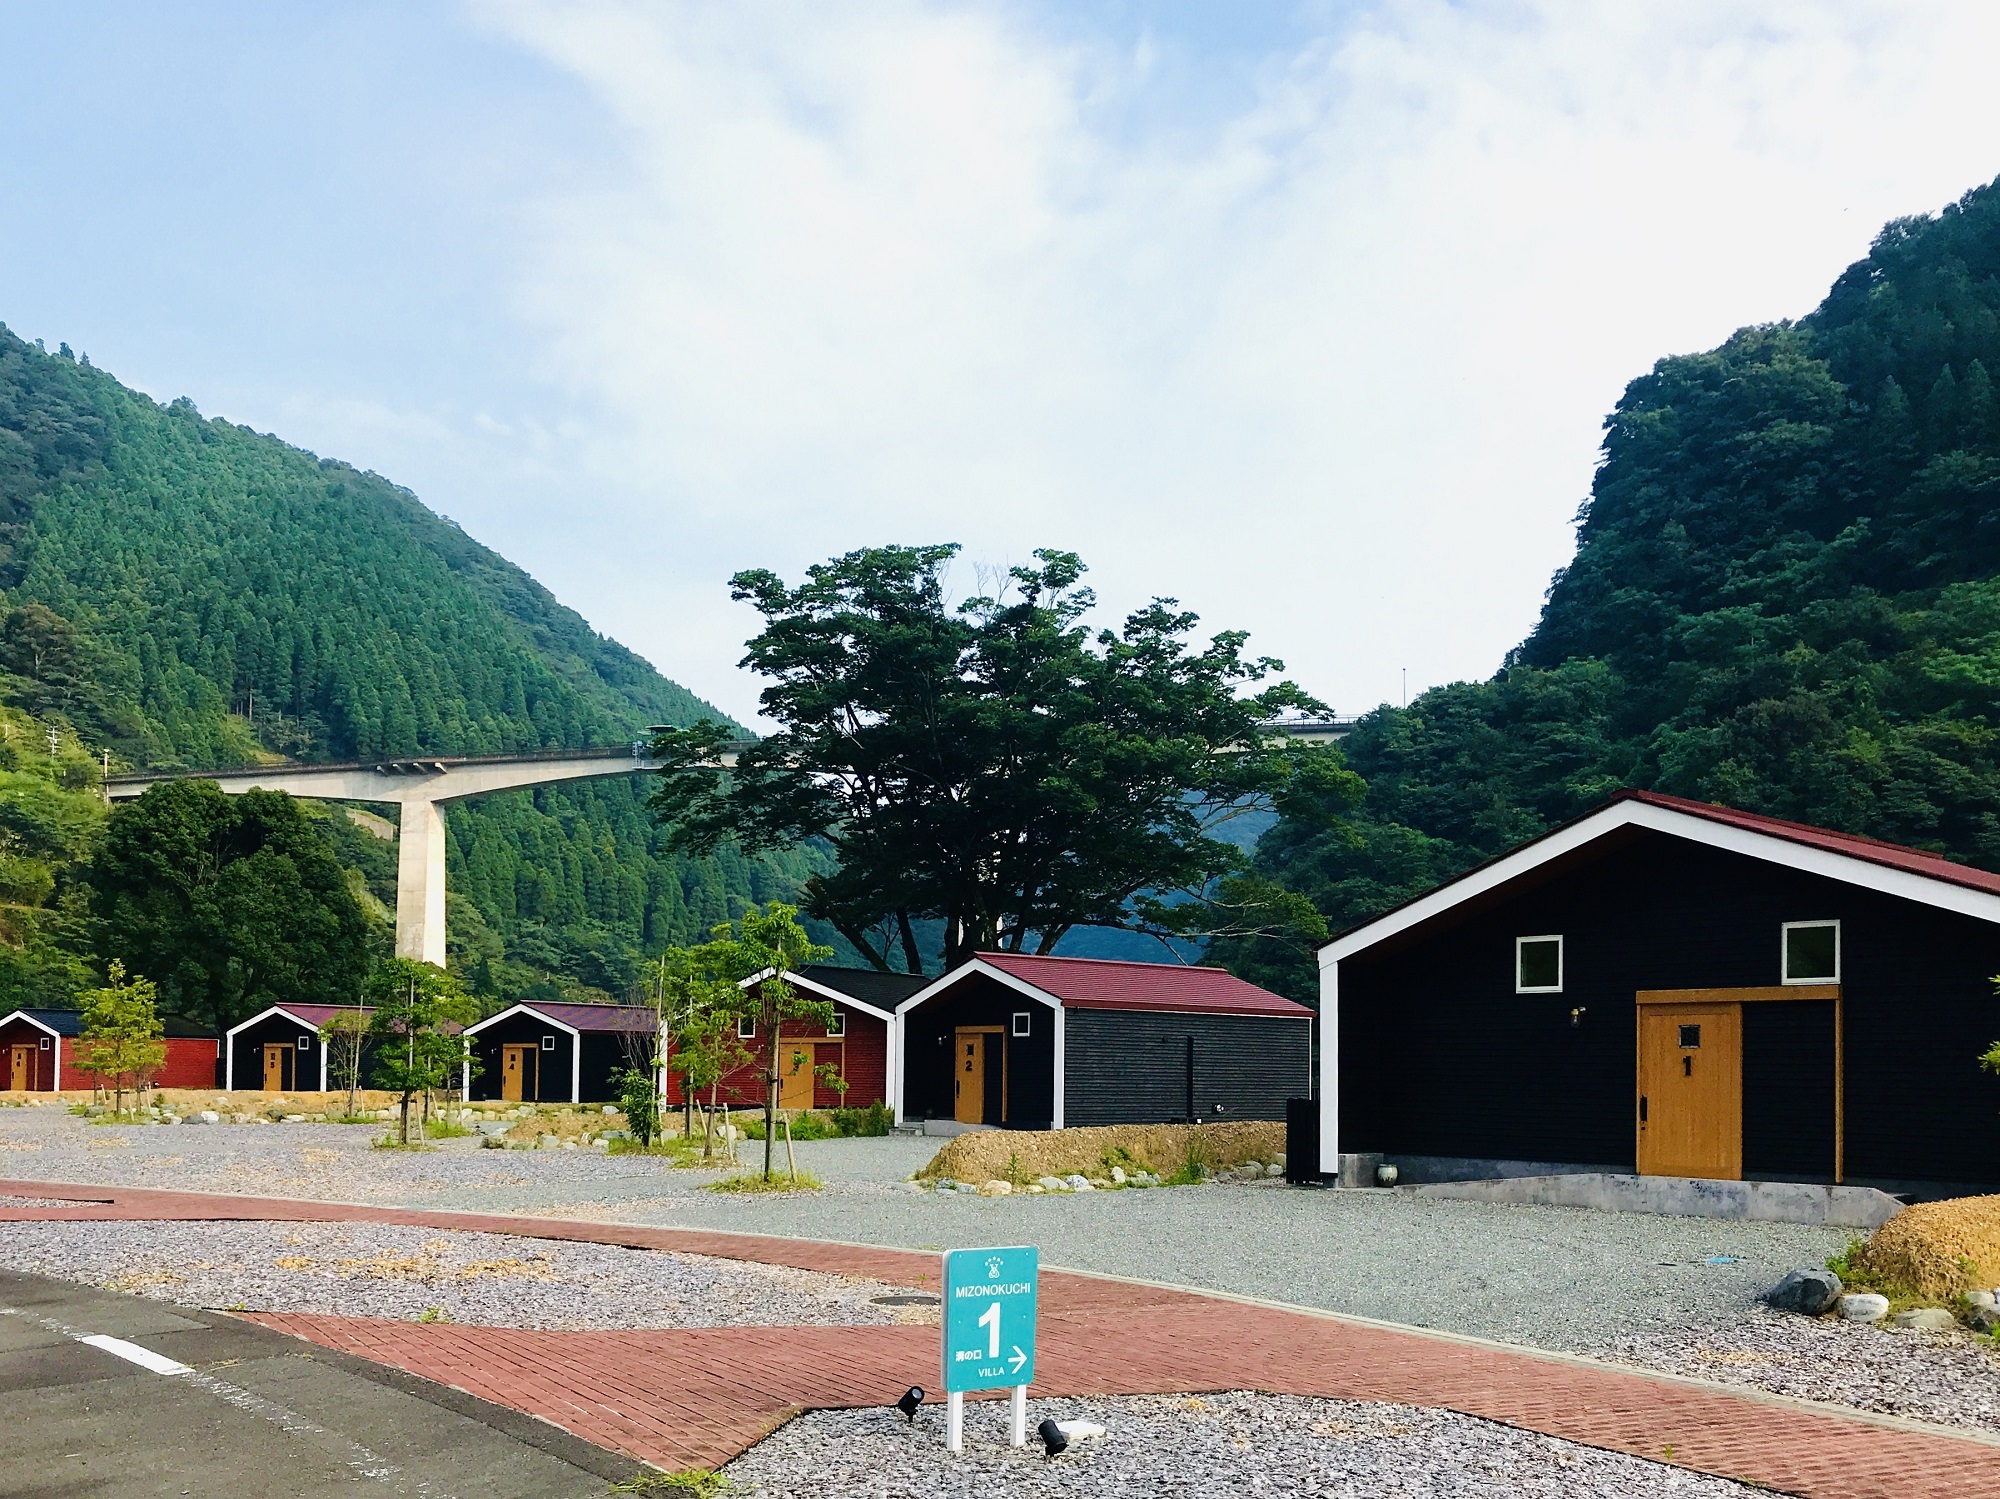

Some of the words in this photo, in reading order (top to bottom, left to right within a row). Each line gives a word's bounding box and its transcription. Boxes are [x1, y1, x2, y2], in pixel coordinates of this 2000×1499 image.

[965, 1060, 973, 1071] 2
[1682, 1056, 1692, 1076] 1
[956, 1283, 1031, 1298] MIZONOKUCHI
[978, 1302, 1001, 1358] 1
[978, 1367, 1005, 1377] VILLA
